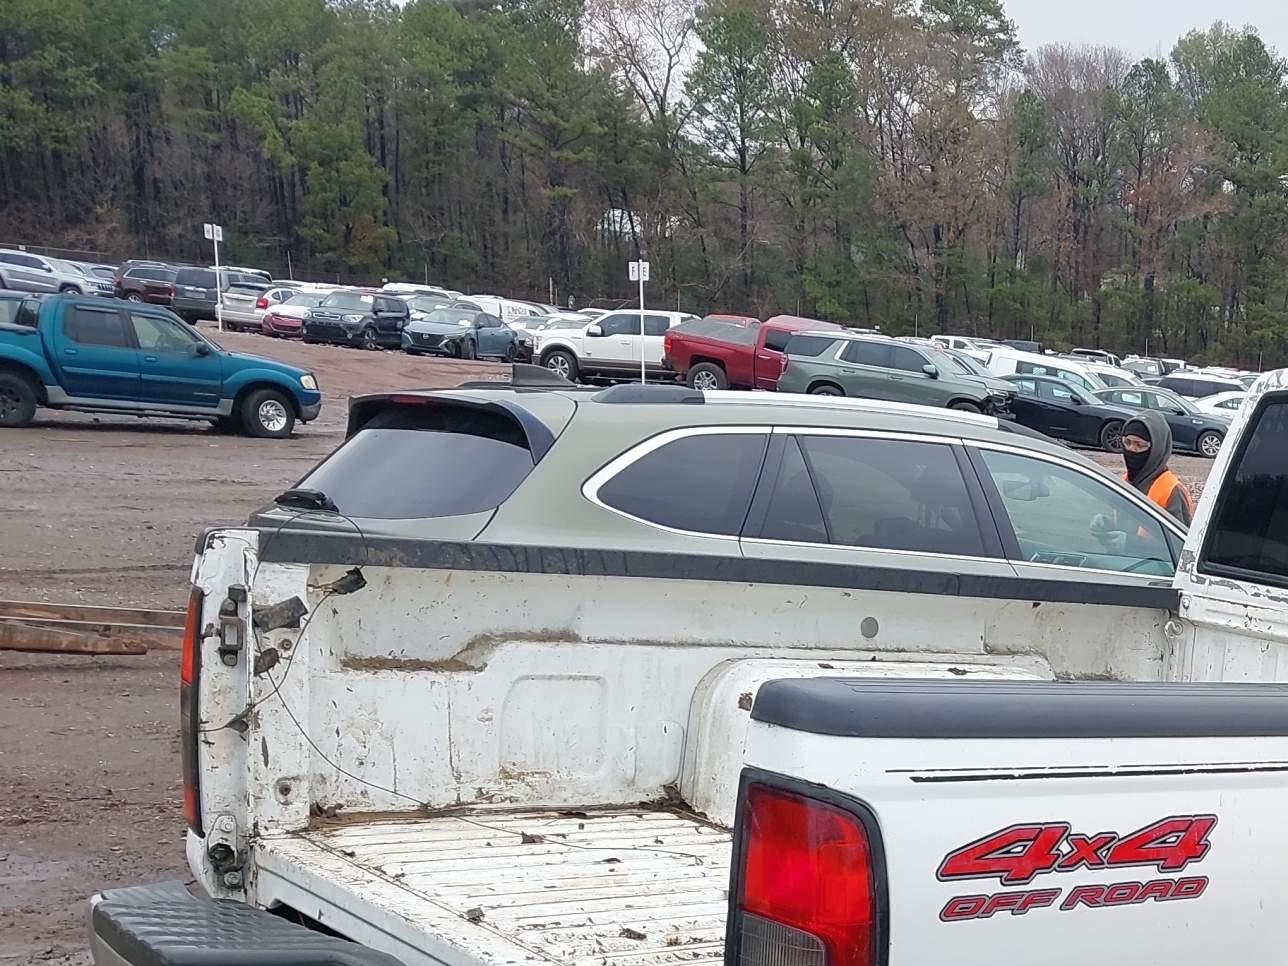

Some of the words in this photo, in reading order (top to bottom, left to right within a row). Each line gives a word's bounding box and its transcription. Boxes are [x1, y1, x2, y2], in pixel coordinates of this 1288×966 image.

[936, 813, 1218, 886] 4x4
[939, 887, 1063, 922] OFF
[1060, 875, 1210, 911] ROAD
